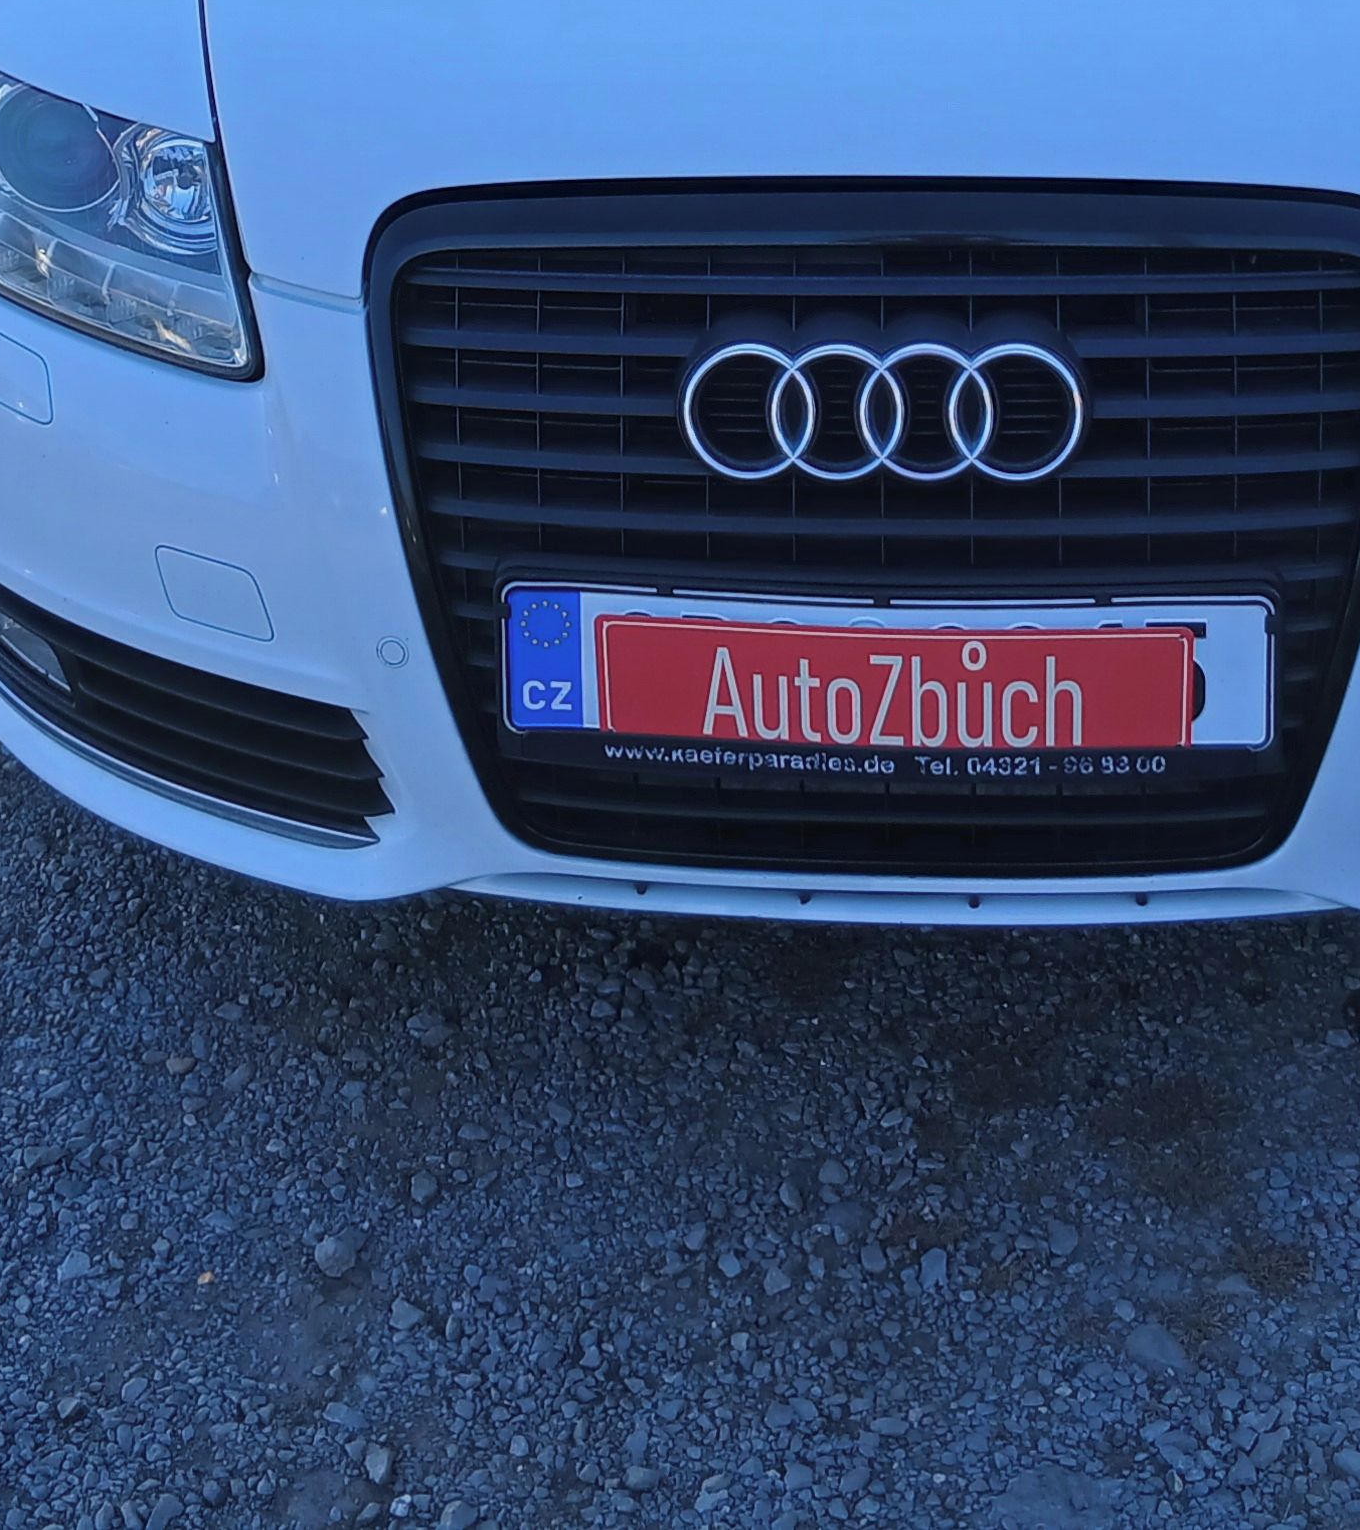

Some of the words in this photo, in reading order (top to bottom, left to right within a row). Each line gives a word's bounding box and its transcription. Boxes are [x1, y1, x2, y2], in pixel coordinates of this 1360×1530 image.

[521, 679, 573, 712] CZ
[702, 640, 1083, 748] AutoZbůch
[913, 755, 959, 776] Tel.
[966, 755, 1040, 776] 04321
